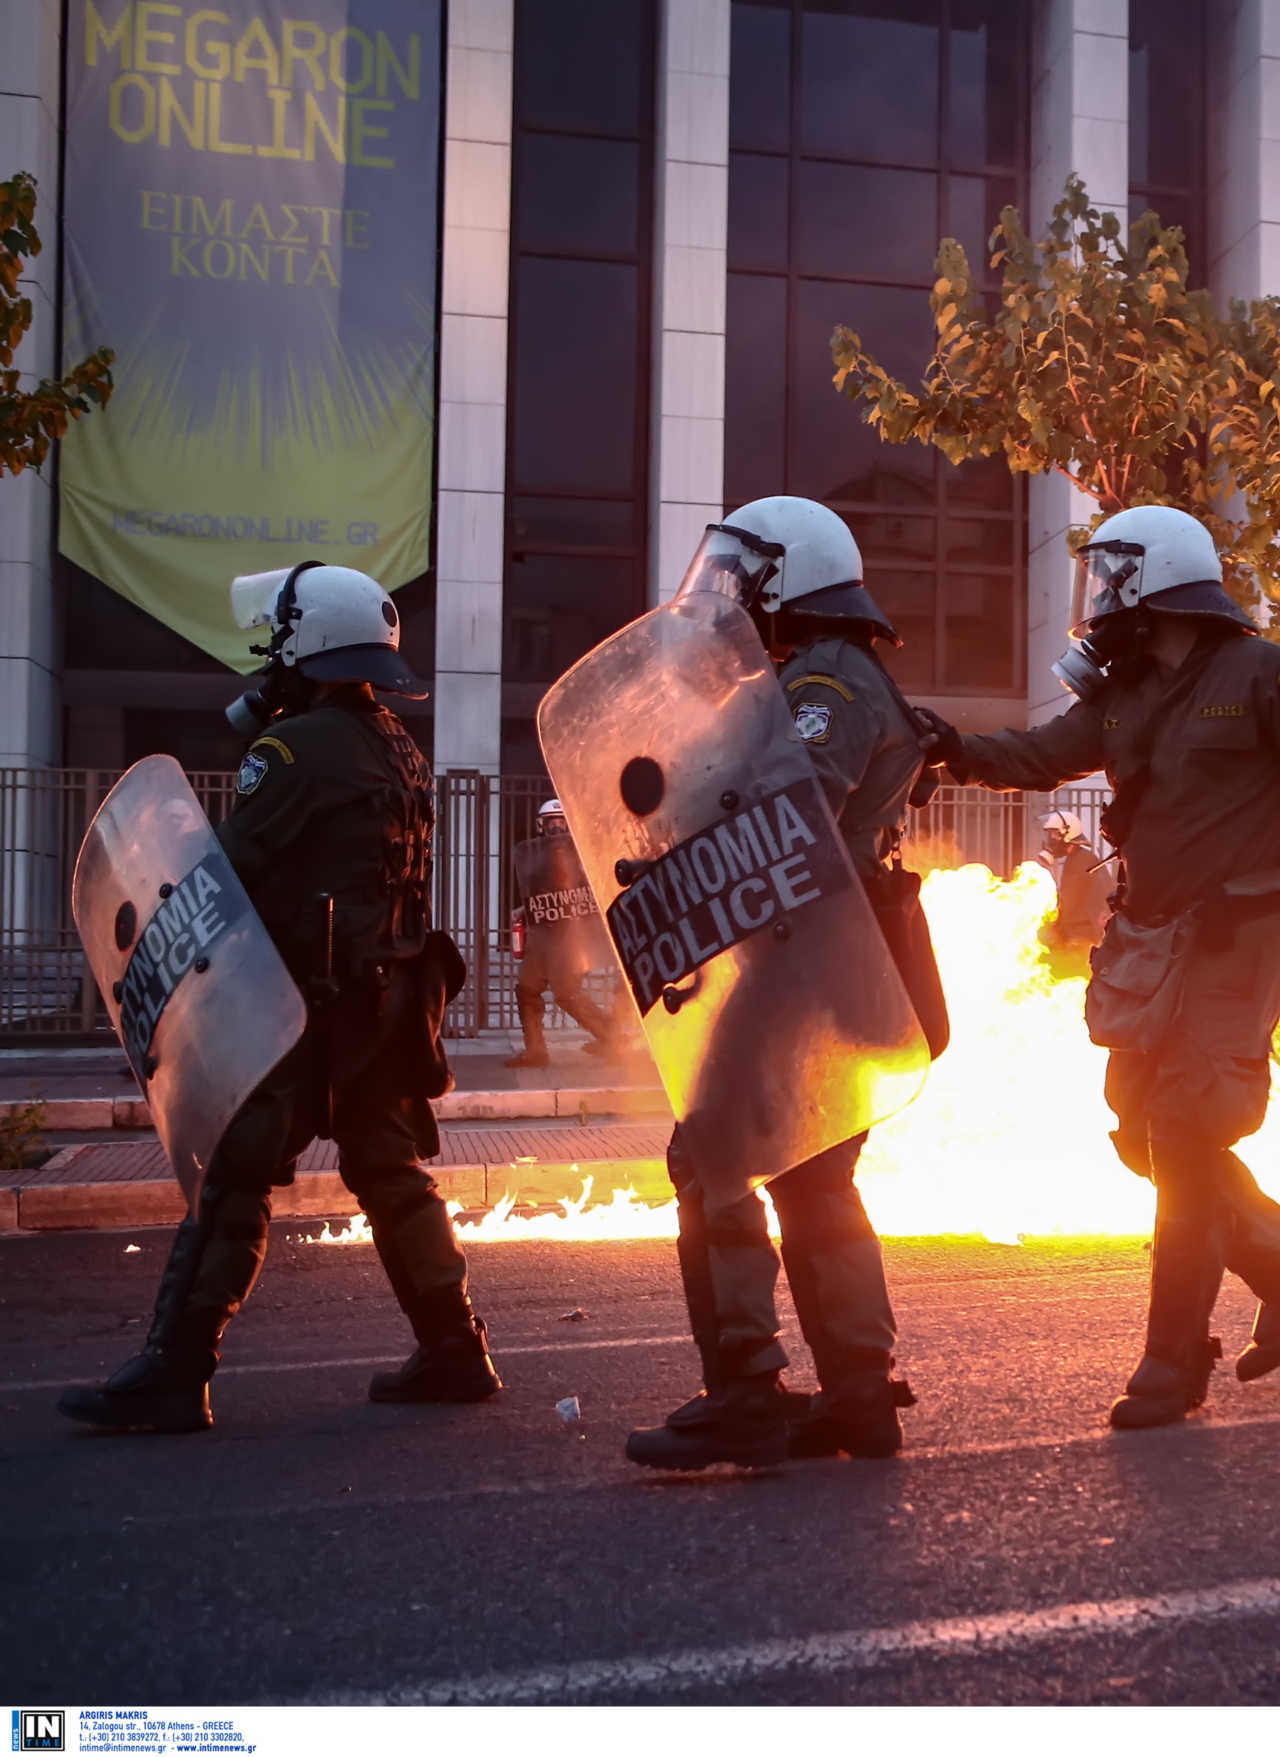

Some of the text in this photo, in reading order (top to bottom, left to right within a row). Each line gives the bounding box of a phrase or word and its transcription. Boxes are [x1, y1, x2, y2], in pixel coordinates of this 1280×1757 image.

[84, 0, 421, 100] MEGARON
[109, 73, 396, 168] ONLINE
[140, 189, 370, 249] ΕΙΜΑΣΤΕ
[171, 236, 342, 288] ΚΟΝΤΑ
[612, 794, 817, 965] ΑΣΤΥΝΟΜΙΑ
[633, 853, 823, 1003] POLICE
